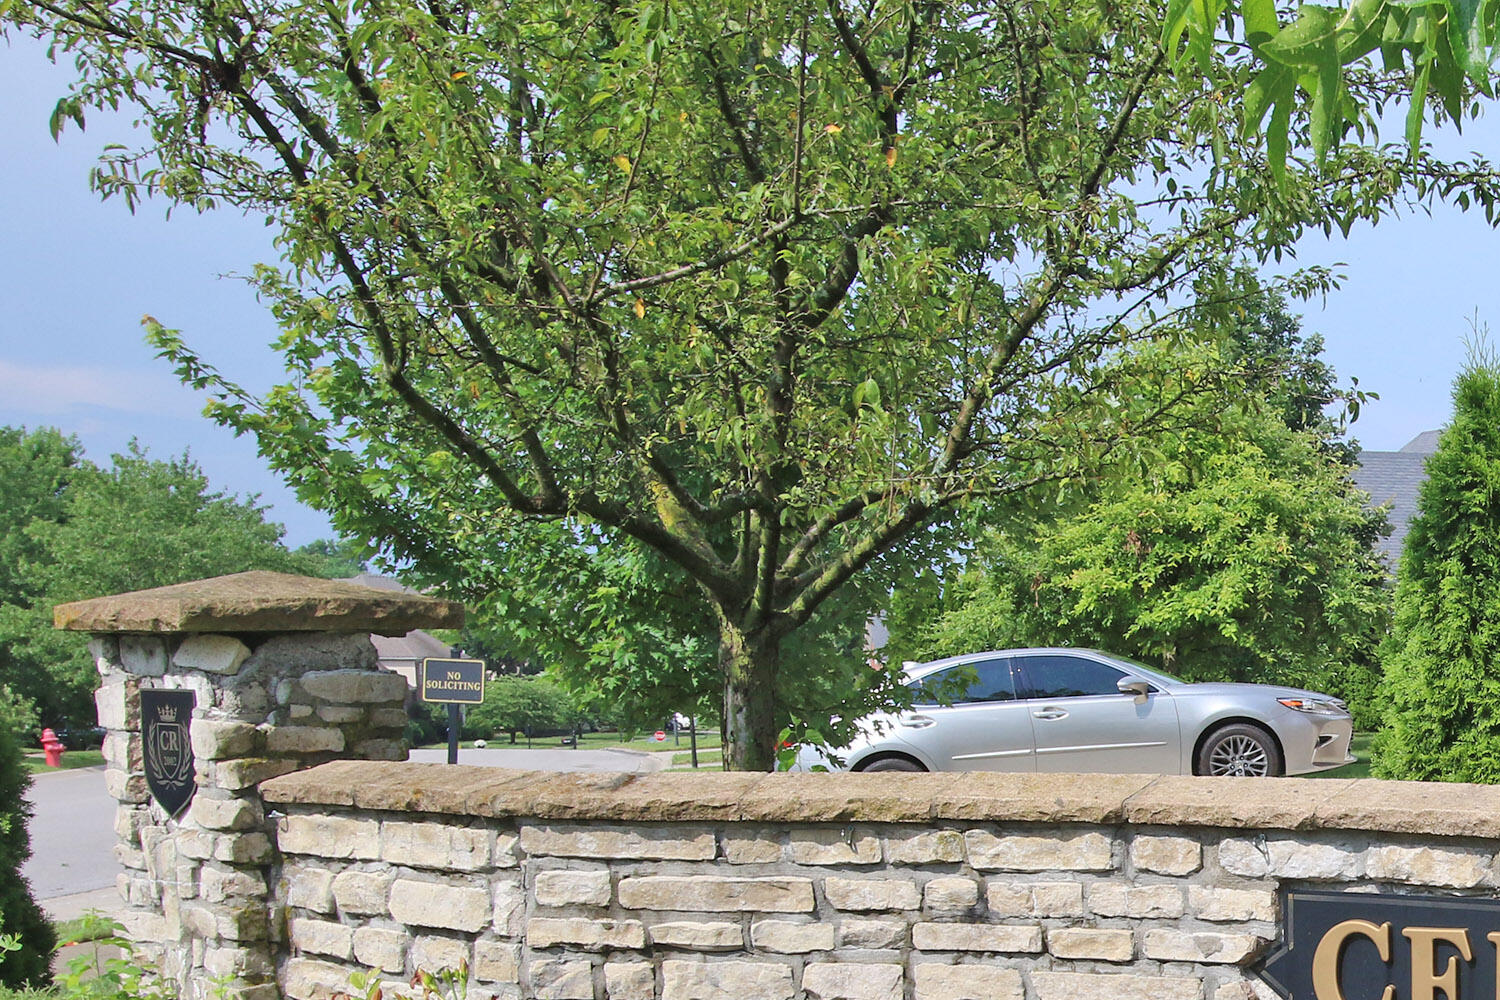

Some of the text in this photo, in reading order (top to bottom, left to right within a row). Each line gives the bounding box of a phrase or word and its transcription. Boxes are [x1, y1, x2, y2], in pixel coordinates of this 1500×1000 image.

[446, 671, 461, 680] NO
[426, 680, 481, 691] SOLICITING
[160, 730, 179, 751] CR
